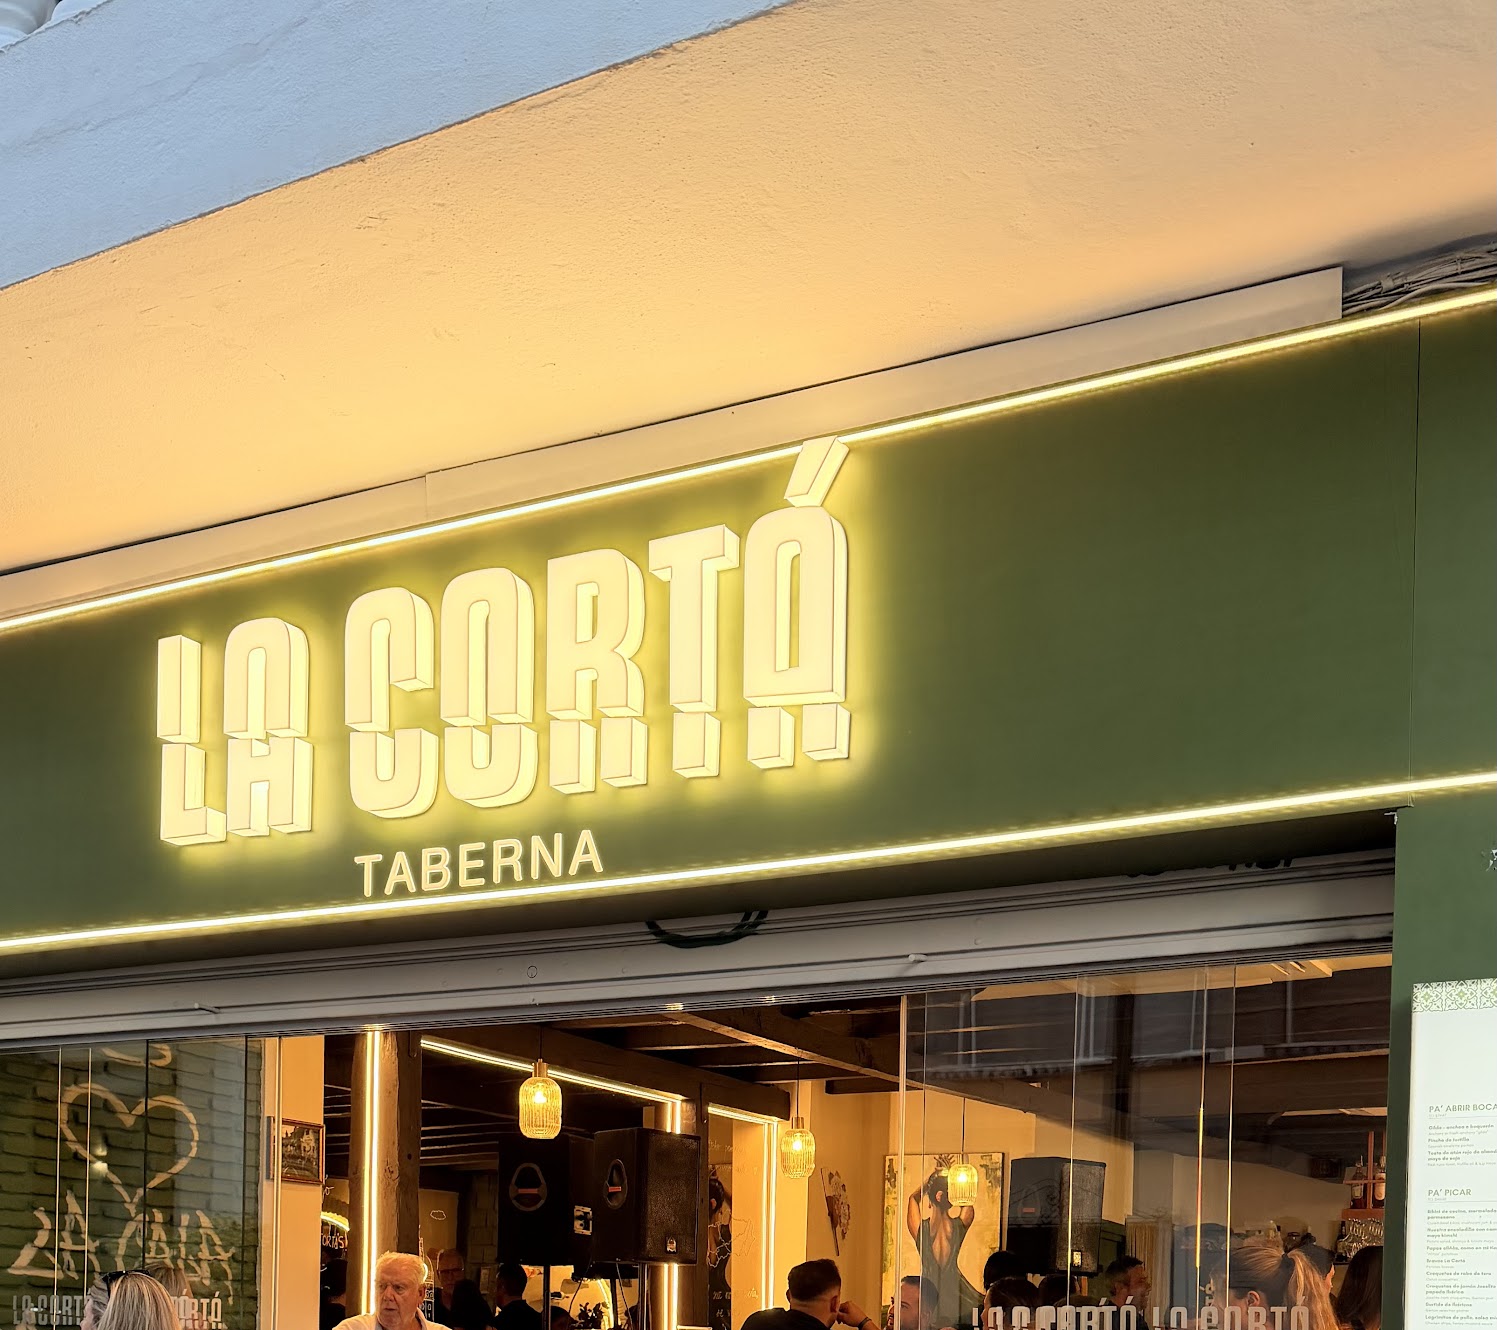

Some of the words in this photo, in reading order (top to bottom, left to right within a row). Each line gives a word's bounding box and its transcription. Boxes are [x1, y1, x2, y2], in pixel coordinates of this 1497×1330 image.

[157, 617, 313, 846] LA
[343, 436, 851, 820] CORTÁ
[354, 830, 604, 898] TABERNA
